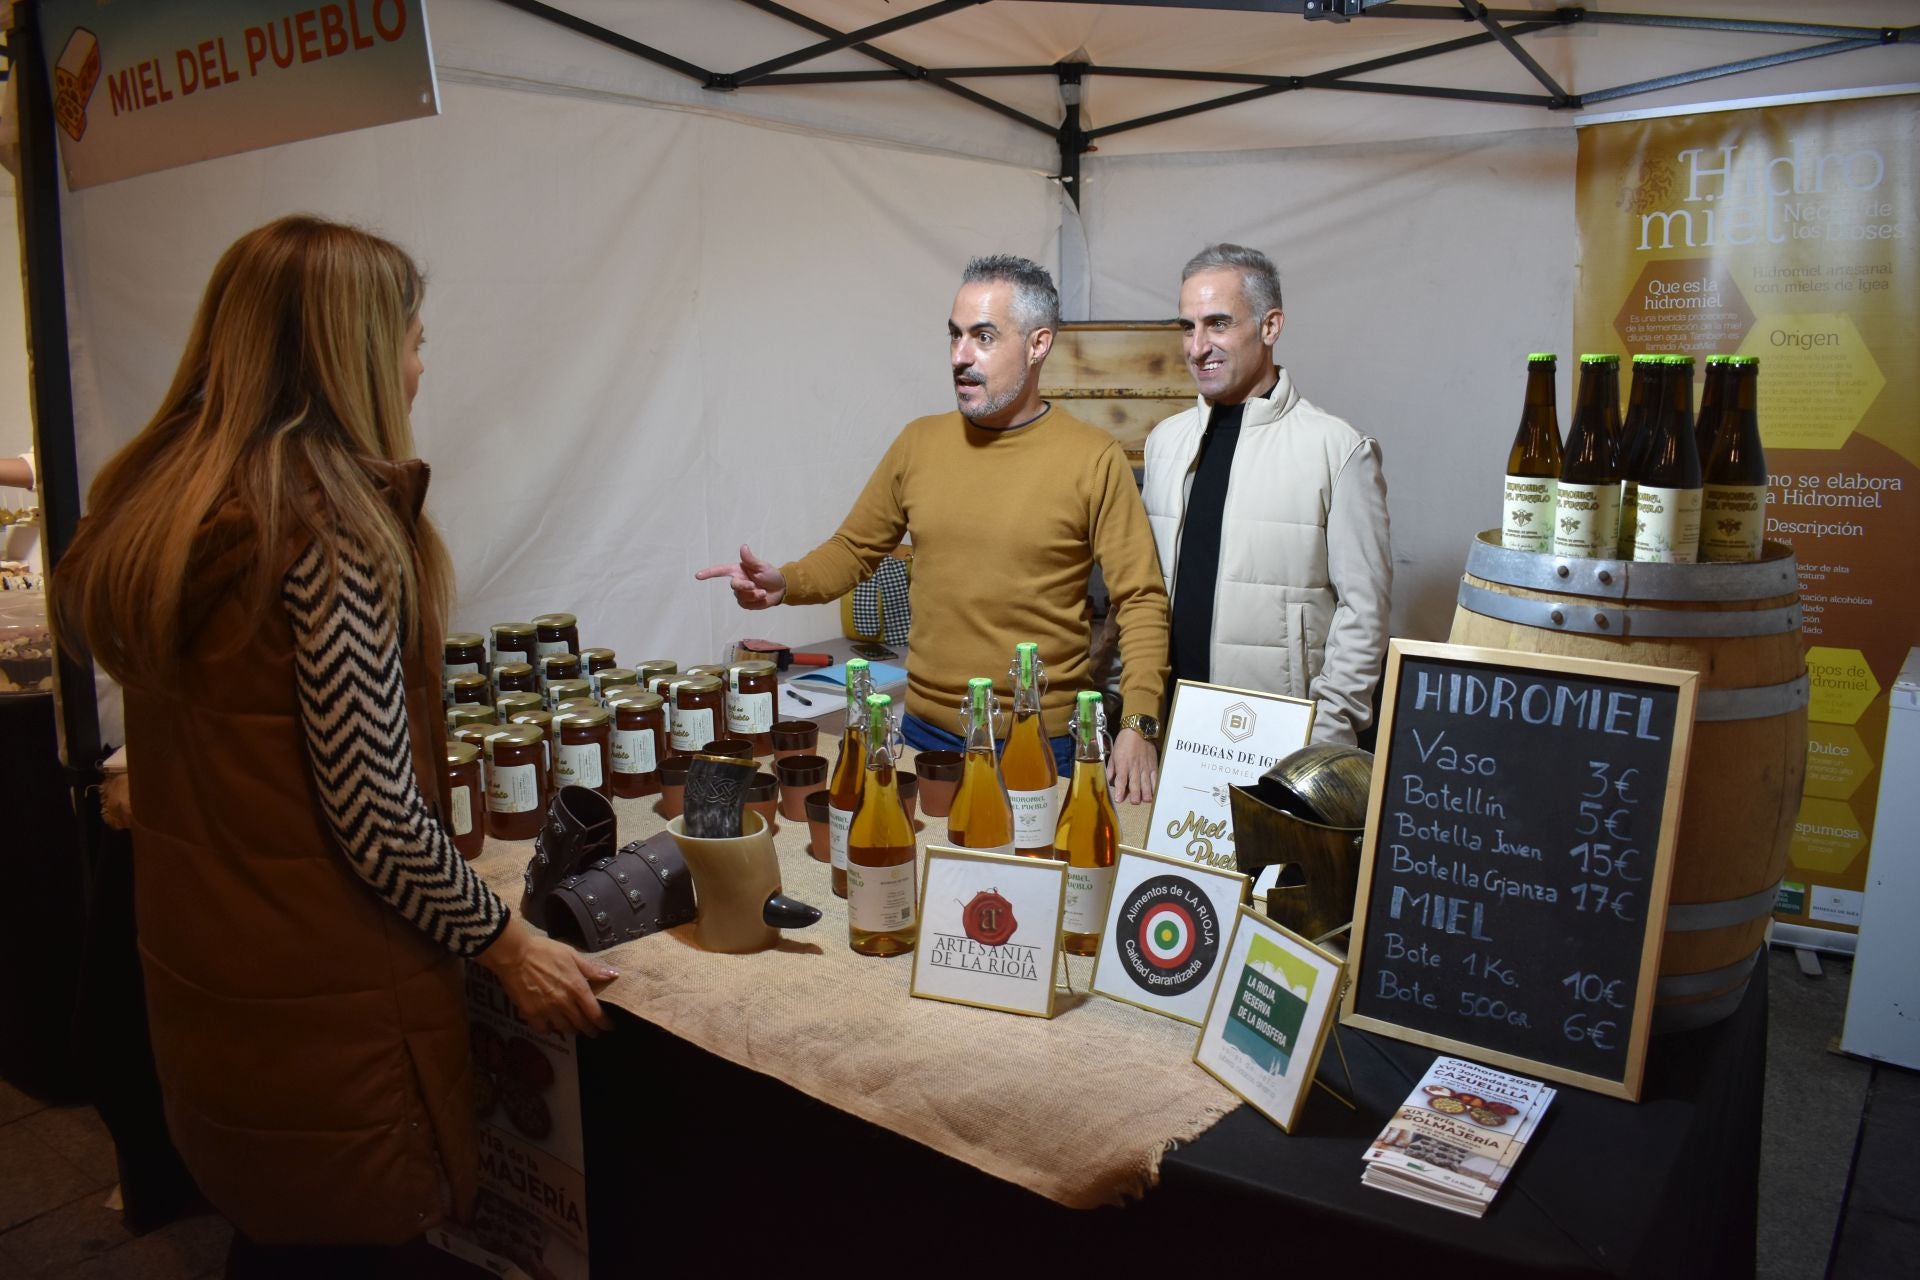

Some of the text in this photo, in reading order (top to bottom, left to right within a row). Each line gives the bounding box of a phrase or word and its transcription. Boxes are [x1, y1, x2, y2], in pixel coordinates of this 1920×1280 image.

[108, 0, 407, 116] MIEL DEL PUEBLO
[1636, 192, 1785, 250] miel
[1865, 200, 1893, 216] de
[1792, 222, 1822, 239] los
[1648, 278, 1718, 296] Que es la
[1754, 278, 1889, 294] con mieles de Igea
[1644, 294, 1723, 310] hidromiel
[1769, 329, 1840, 351] Origen
[1798, 475, 1820, 488] se
[1826, 472, 1902, 491] elabora
[1783, 489, 1882, 509] Hidromiel
[1766, 518, 1864, 538] Descripción
[1820, 564, 1831, 573] de
[1846, 665, 1866, 678] de
[1414, 670, 1661, 741] HIDROMIEL
[1175, 739, 1234, 761] BODEGAS
[1237, 751, 1256, 765] DE
[1412, 728, 1497, 776] Vaso
[1808, 740, 1850, 756] Dulce
[1402, 774, 1506, 820] Botellín
[1166, 810, 1227, 841] Miel
[1393, 812, 1643, 881] Botella Joven 15€
[1390, 844, 1479, 889] Botella
[1570, 883, 1636, 922] 17€
[1126, 884, 1215, 946] Alimentos de LA RIOJA
[1389, 884, 1493, 943] MIEL
[930, 949, 1038, 979] DE LA RIOJA
[1125, 939, 1204, 986] Calidad garantizada
[1383, 932, 1442, 968] Bote
[1561, 970, 1627, 1008] 10€
[1247, 974, 1257, 990] LA
[1242, 989, 1272, 1018] RESERVA
[1375, 969, 1438, 1009] Bote
[1563, 1013, 1617, 1050] 6€
[1237, 1005, 1287, 1049] DE LA BIOSFERA
[1434, 1069, 1529, 1101] CAZUELILLA
[1437, 1064, 1457, 1072] XVI
[1457, 1068, 1508, 1088] Jornadas
[1448, 1060, 1538, 1089] Calahorra 2025
[1401, 1113, 1500, 1149] GOLMAJERÍA
[1404, 1108, 1424, 1116] XIX
[1426, 1113, 1455, 1126] Feria
